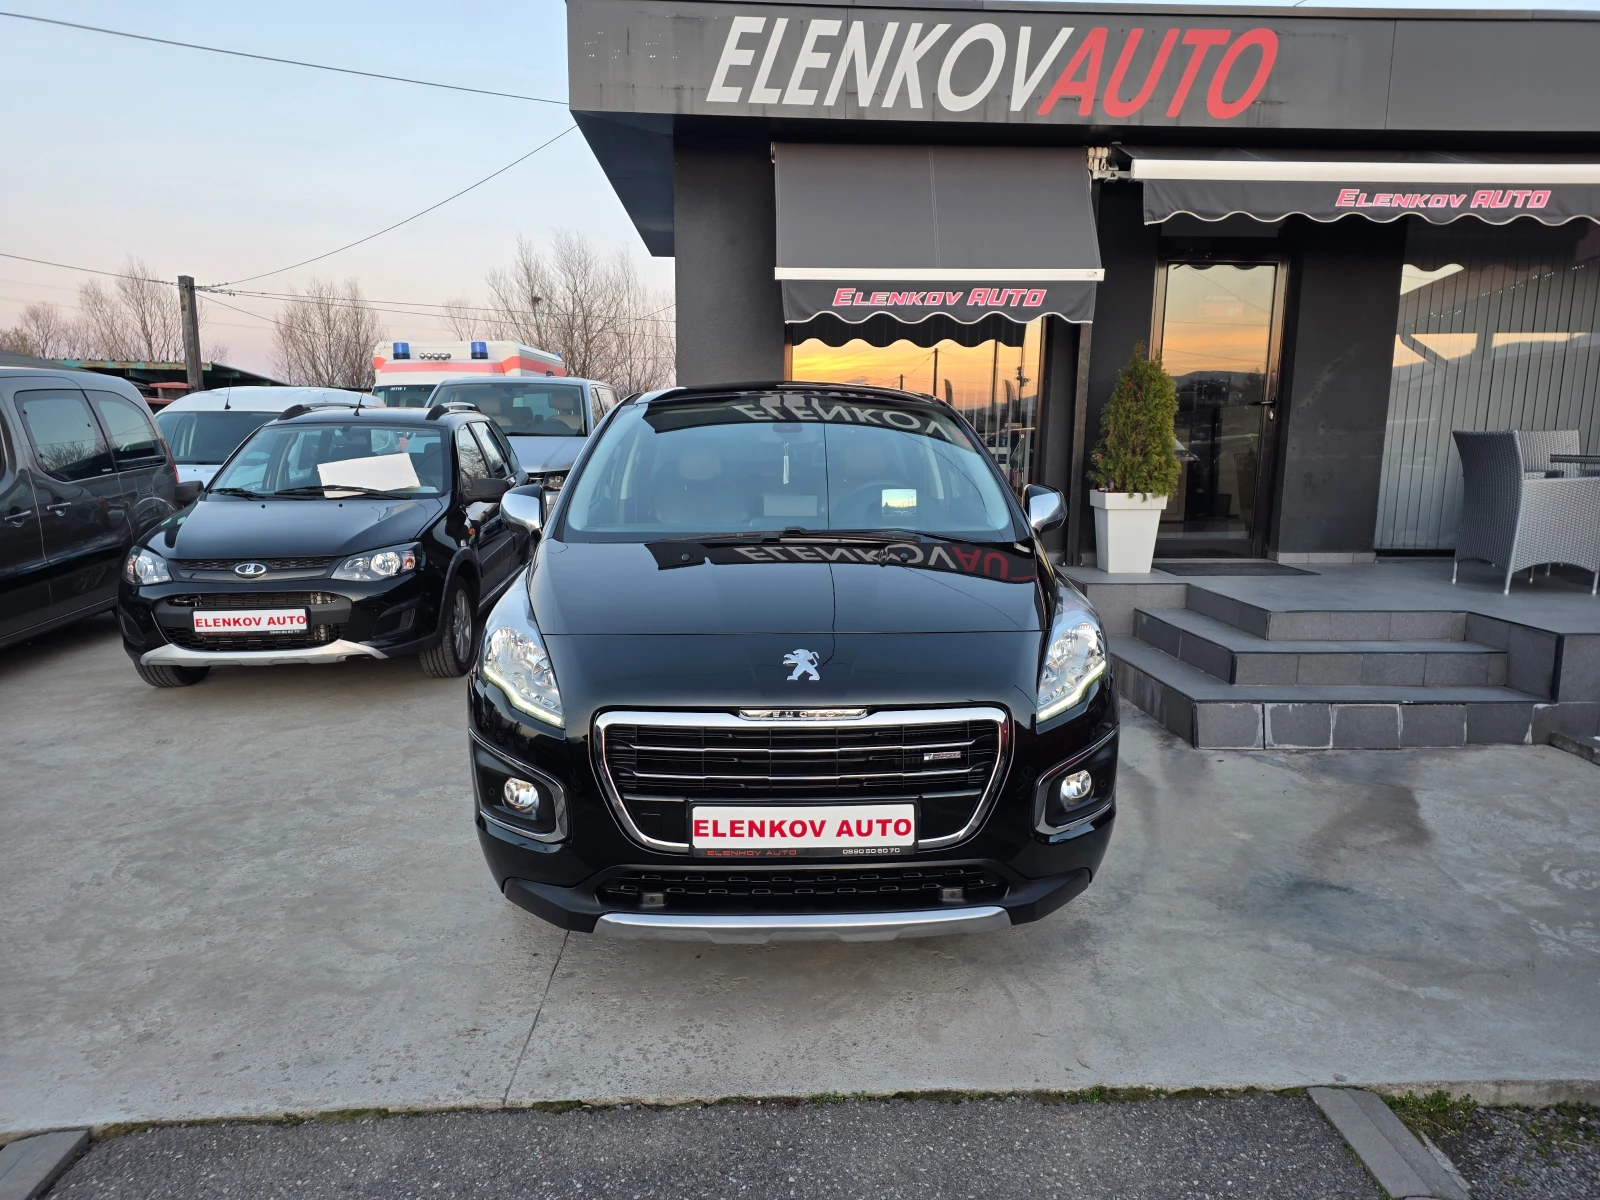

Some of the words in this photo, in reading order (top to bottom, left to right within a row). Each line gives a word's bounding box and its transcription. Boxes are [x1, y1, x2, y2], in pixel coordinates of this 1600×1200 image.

[1335, 188, 1467, 208] ELENKOV
[1470, 189, 1551, 208] AUTO
[832, 288, 963, 306] ELENKOV
[966, 288, 1047, 306] AUTO
[195, 617, 262, 628] ELENKOV
[267, 615, 307, 626] AUTO
[693, 819, 827, 838] ELENKOV
[835, 818, 912, 837] AUTO
